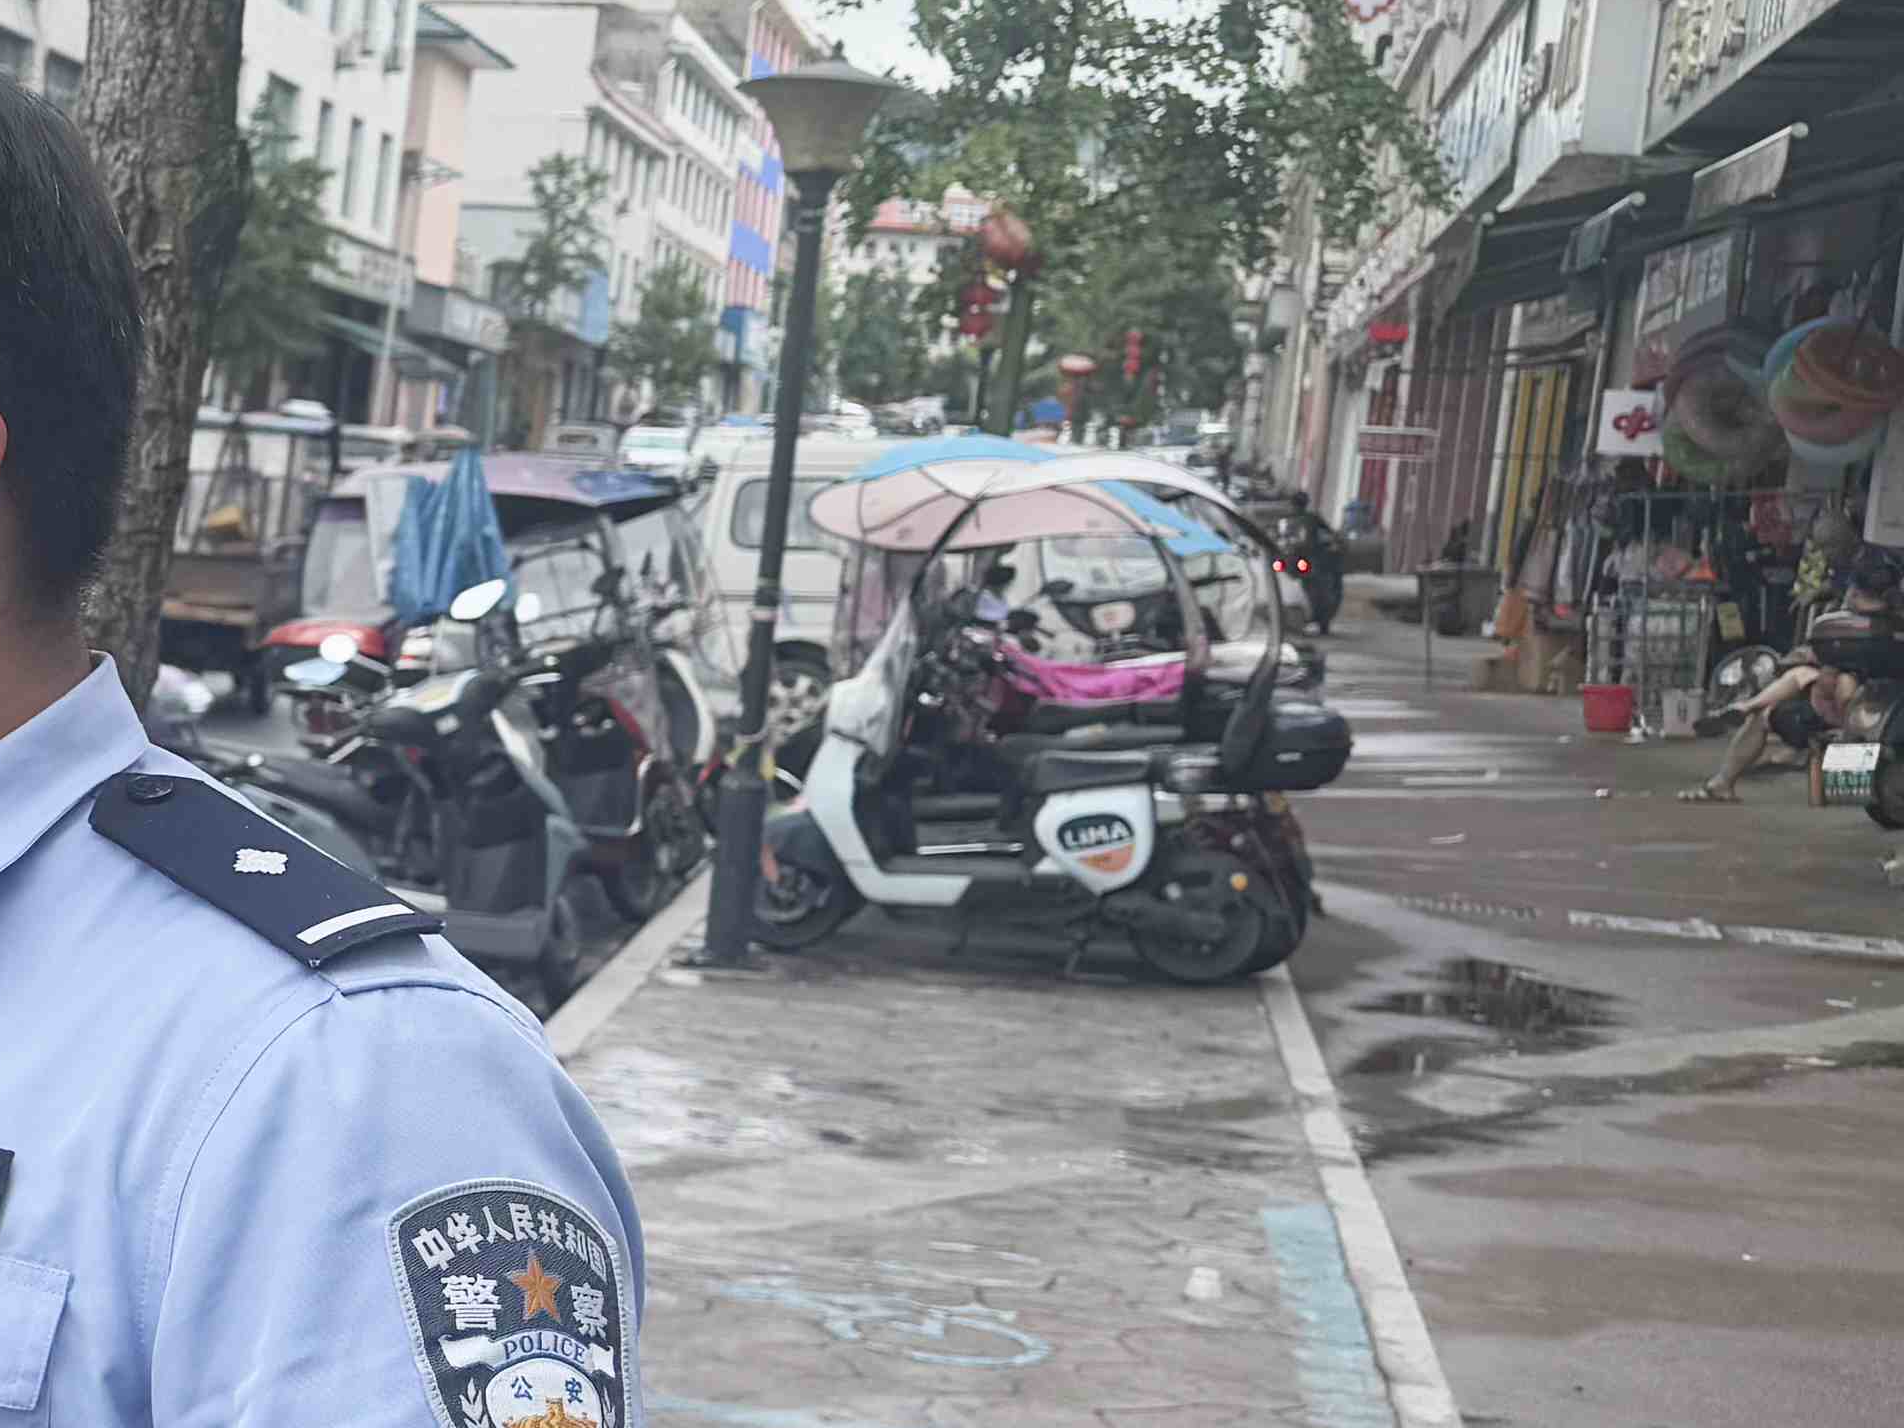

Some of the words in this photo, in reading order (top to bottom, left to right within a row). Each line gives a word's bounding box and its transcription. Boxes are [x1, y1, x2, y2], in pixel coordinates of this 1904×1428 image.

[411, 1201, 609, 1276] 中华人民共和国
[504, 1334, 586, 1364] POLICE
